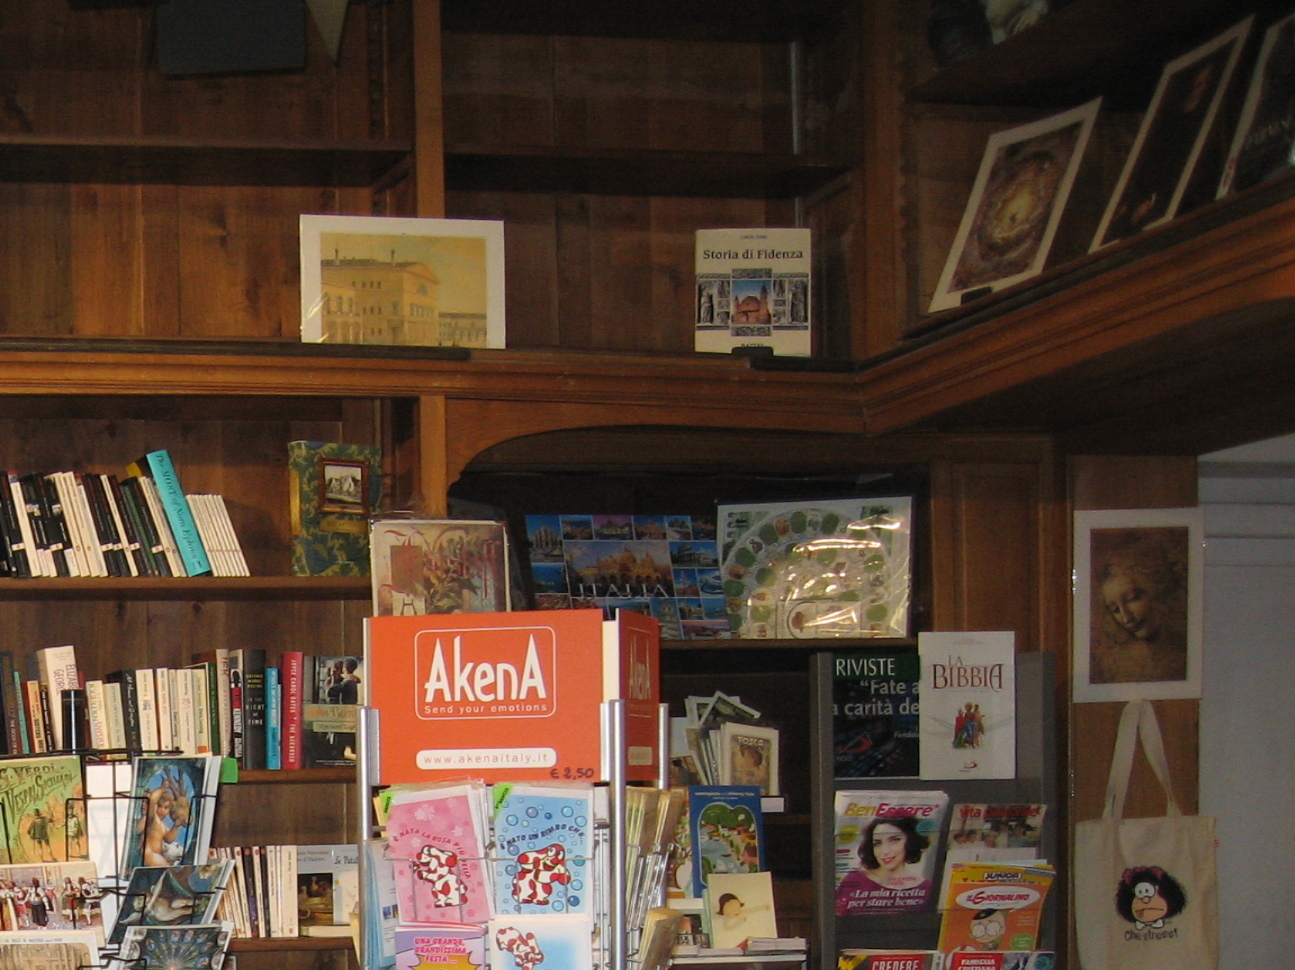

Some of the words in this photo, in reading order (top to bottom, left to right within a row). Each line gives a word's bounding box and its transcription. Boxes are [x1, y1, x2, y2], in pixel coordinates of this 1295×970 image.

[703, 250, 738, 260] Storia
[742, 248, 753, 259] di
[757, 249, 804, 259] Fidenza
[836, 658, 896, 676] RIVISTE
[948, 655, 963, 667] LA
[424, 633, 547, 703] AkenA
[932, 663, 1003, 690] BIBBIA
[424, 704, 453, 714] Send
[458, 705, 485, 715] your
[490, 702, 547, 712] emotions
[844, 700, 893, 715] carità
[736, 734, 765, 747] TOSCA
[423, 753, 548, 765] www.akenaitaly.it
[550, 768, 558, 779] €
[561, 767, 595, 780] 2,50
[870, 889, 889, 898] mia
[891, 888, 926, 897] ricetta
[864, 898, 892, 906] stare
[1125, 930, 1141, 941] Che
[414, 938, 432, 946] UNA
[414, 946, 467, 955] GRANDISSIMA
[961, 958, 995, 966] FAMIGLIA
